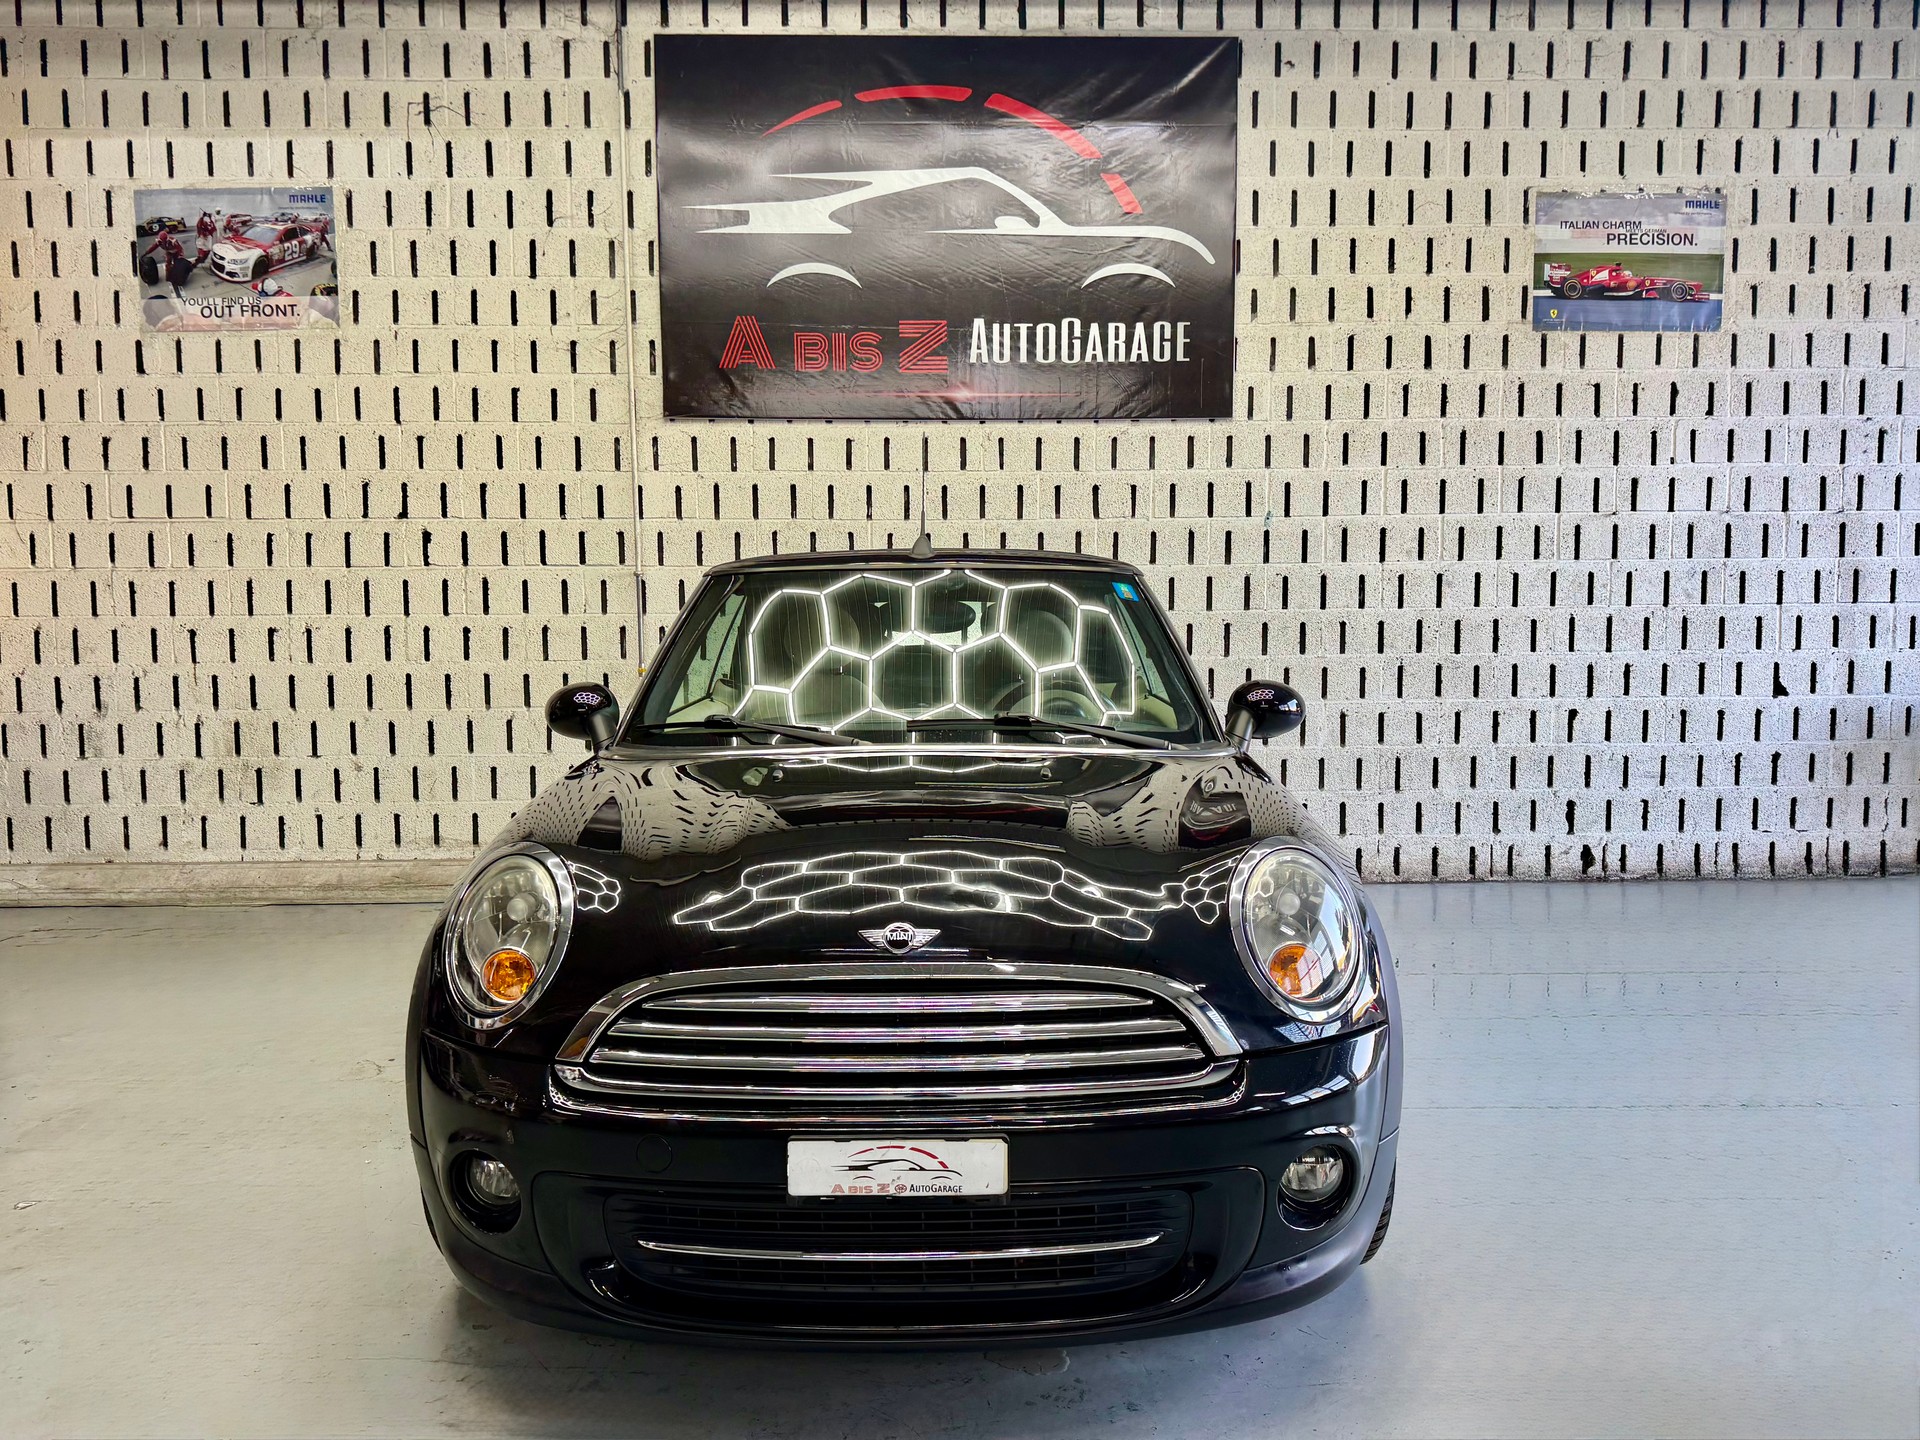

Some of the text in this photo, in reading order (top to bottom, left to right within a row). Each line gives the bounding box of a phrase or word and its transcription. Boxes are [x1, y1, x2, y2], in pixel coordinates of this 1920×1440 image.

[289, 194, 326, 203] MAHLE
[1685, 201, 1720, 209] MAHLE
[1560, 220, 1642, 230] ITALIAN CHARM
[1607, 233, 1698, 246] PRECISION.
[284, 241, 300, 260] 29
[182, 296, 262, 306] YOU'LL FIND US
[200, 304, 300, 318] OUT FRONT.
[719, 315, 776, 369] A
[794, 331, 883, 372] BIS
[899, 320, 948, 373] Z
[887, 932, 911, 941] MINI
[831, 1183, 846, 1194] A
[877, 1183, 890, 1194] Z
